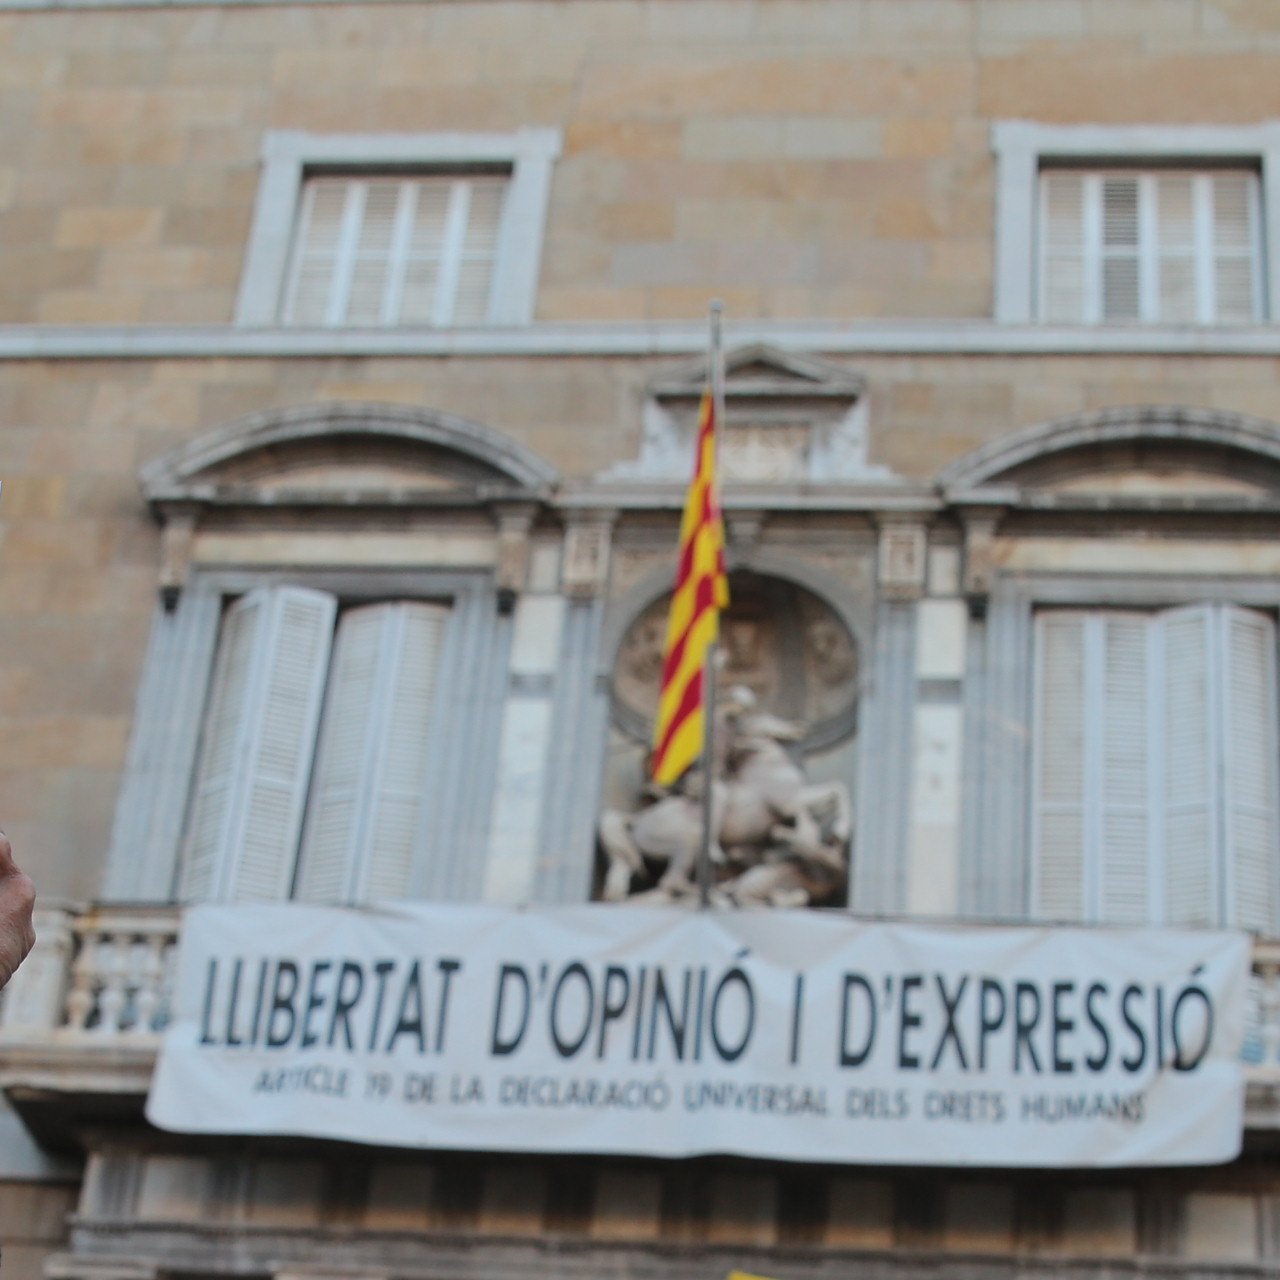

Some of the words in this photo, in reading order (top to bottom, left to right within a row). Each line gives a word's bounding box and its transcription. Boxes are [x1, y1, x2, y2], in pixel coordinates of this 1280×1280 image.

[200, 955, 462, 1054] LLIBERTAT
[490, 948, 755, 1063] D'OPINIÓ
[789, 972, 806, 1064] I
[838, 963, 1215, 1073] D'EXPRESSIÓ
[254, 1065, 349, 1098] ARTICLE
[403, 1073, 436, 1104] DE
[450, 1076, 484, 1105] LA
[683, 1082, 828, 1118] UNIVERSAL
[845, 1087, 909, 1120] DELS
[923, 1089, 1007, 1123] DRETS
[1021, 1089, 1147, 1126] HUMANS
